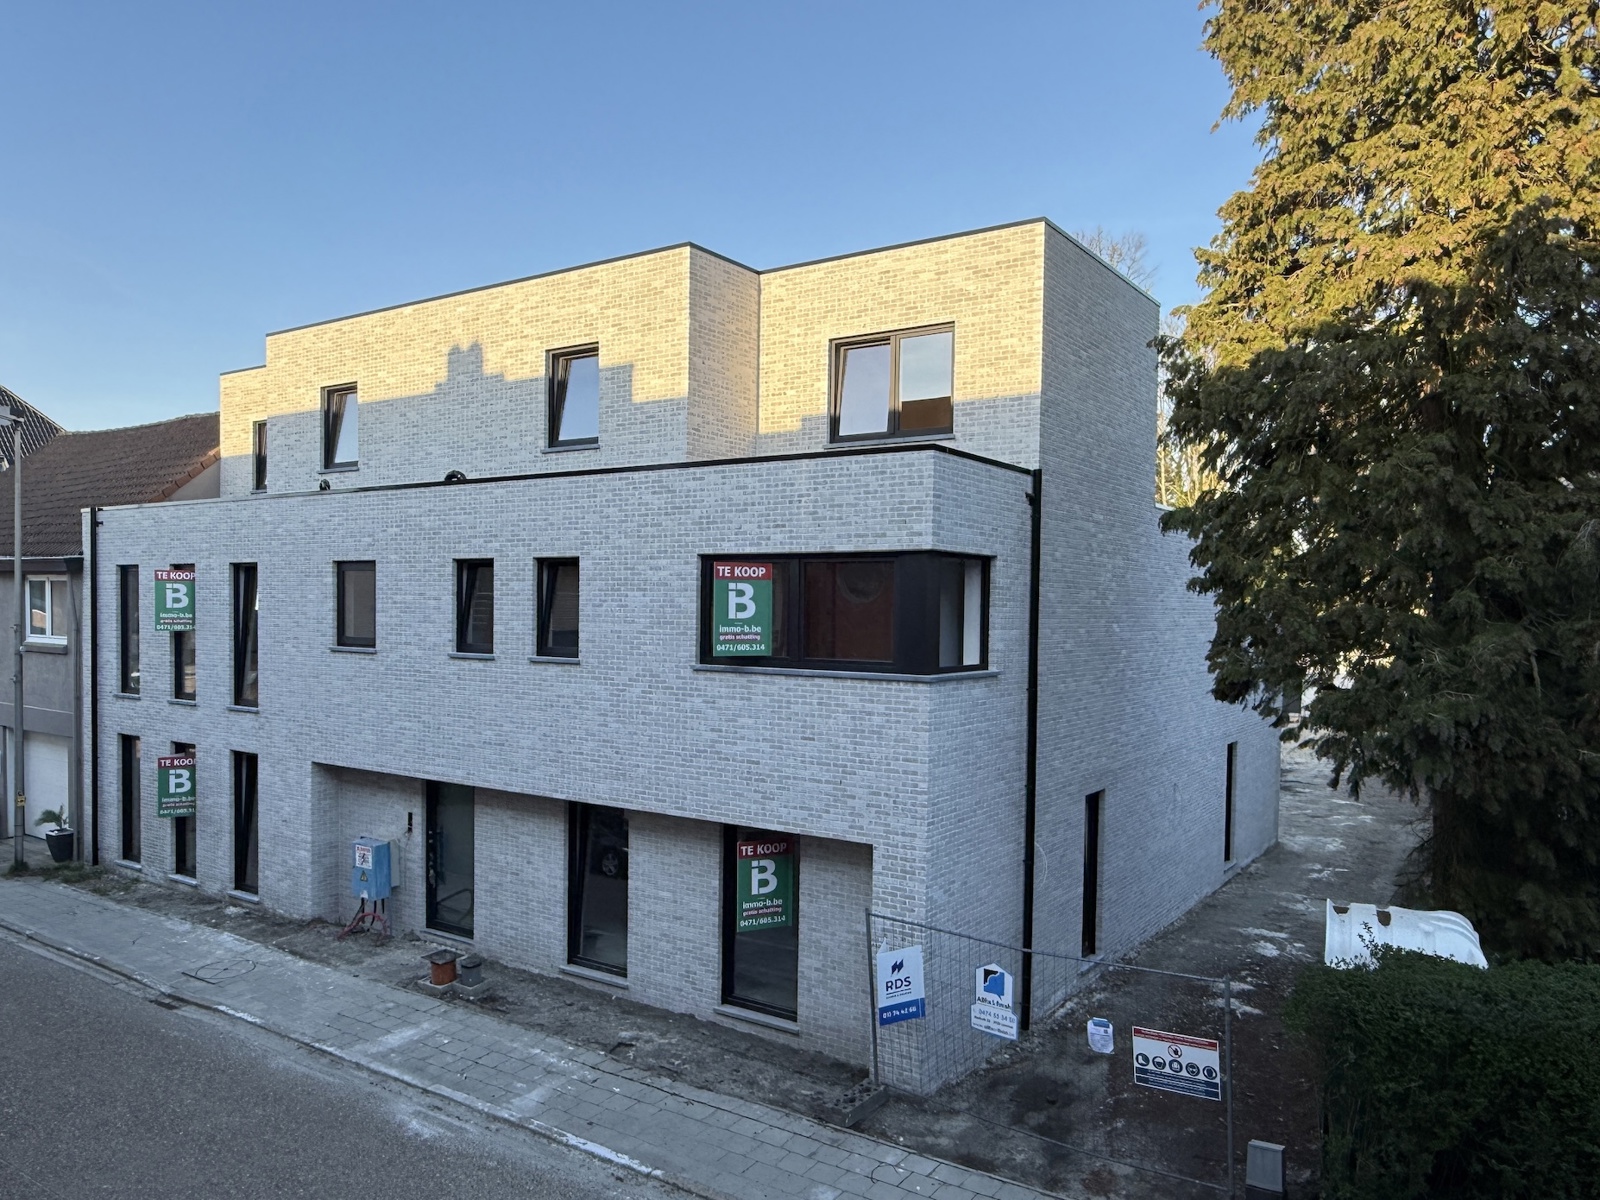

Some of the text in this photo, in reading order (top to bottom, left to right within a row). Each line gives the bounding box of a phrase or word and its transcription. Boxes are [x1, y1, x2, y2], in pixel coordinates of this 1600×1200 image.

[717, 566, 766, 577] TE KOOP
[741, 843, 787, 856] TE KOOP
[743, 898, 782, 909] immo-b.be
[740, 915, 785, 927] 0471/605.314
[886, 976, 911, 992] RDS
